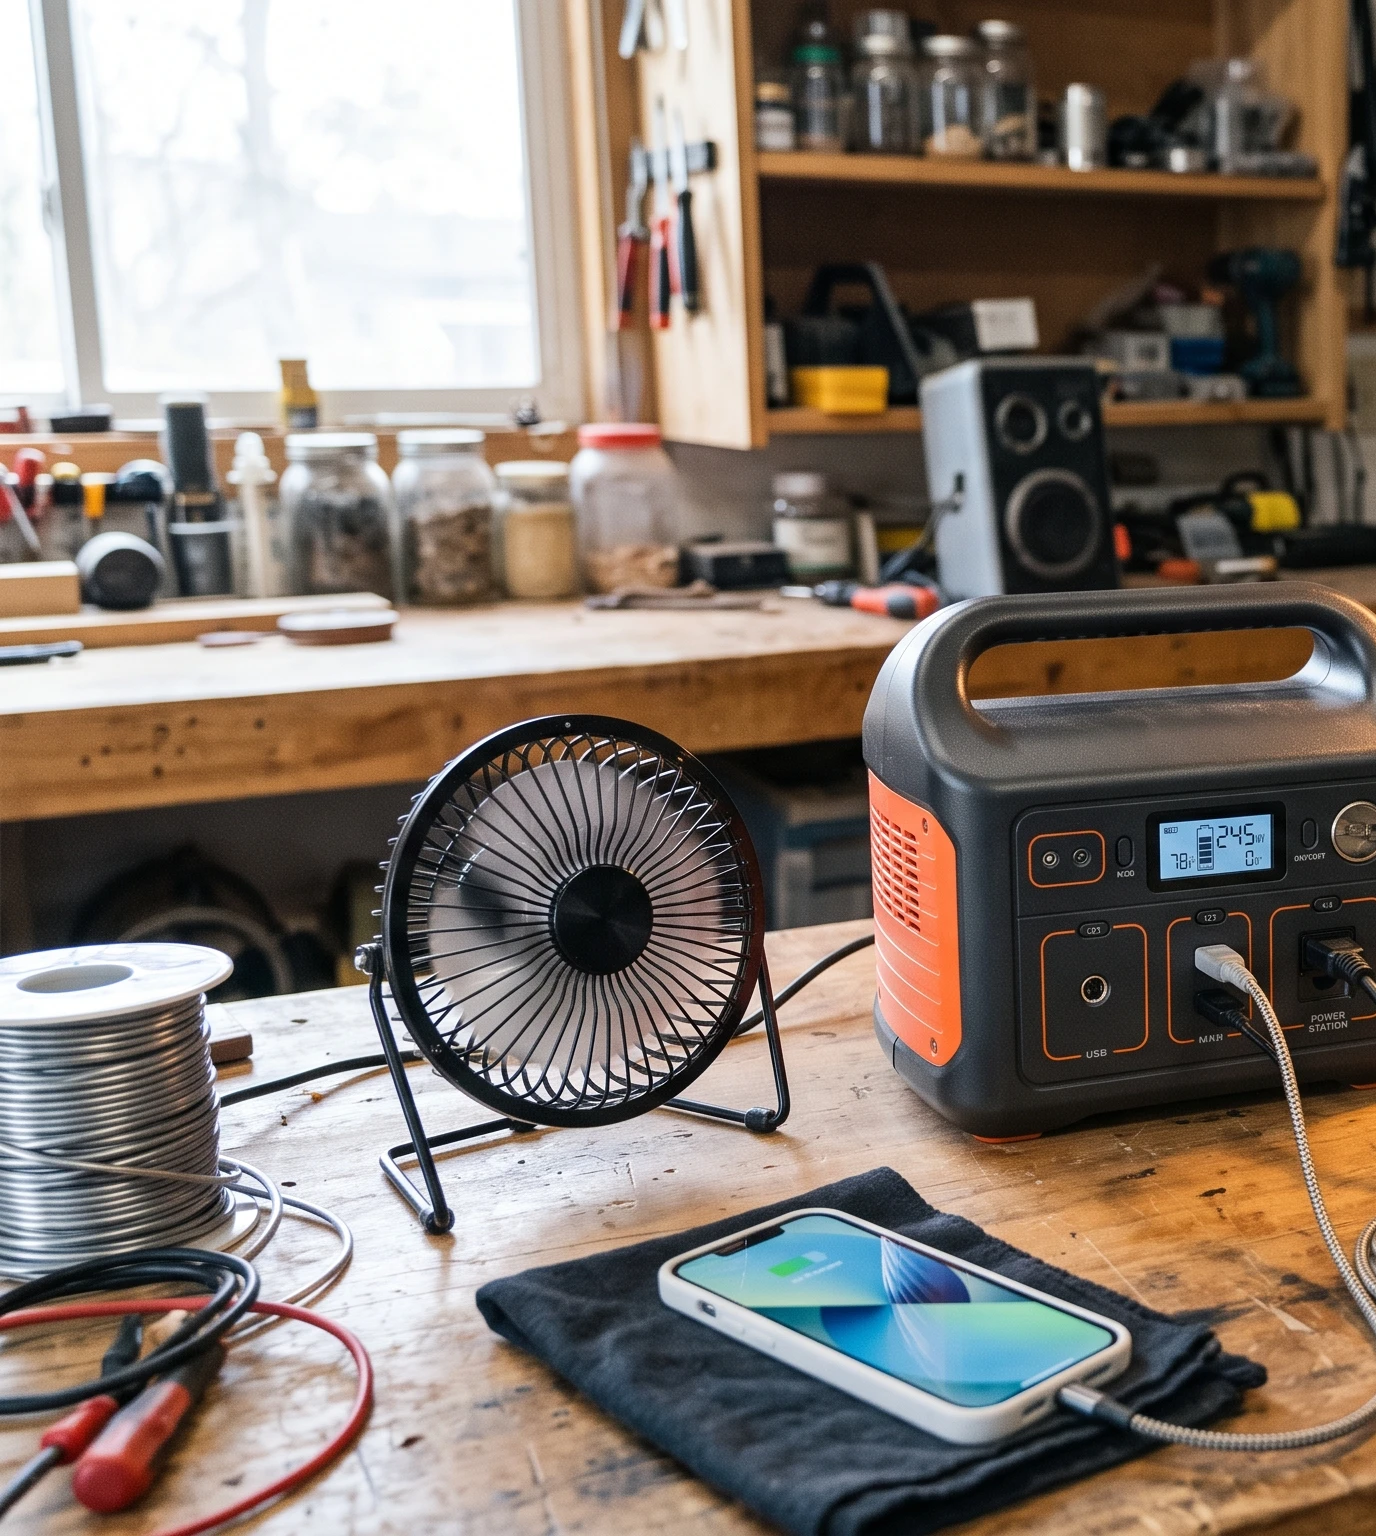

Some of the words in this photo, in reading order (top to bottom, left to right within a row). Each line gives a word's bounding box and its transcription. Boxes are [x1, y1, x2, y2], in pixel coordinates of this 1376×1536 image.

[1217, 823, 1254, 848] 245
[1311, 1011, 1346, 1023] POWER
[1308, 1020, 1349, 1034] STATION
[1085, 1048, 1108, 1060] USB
